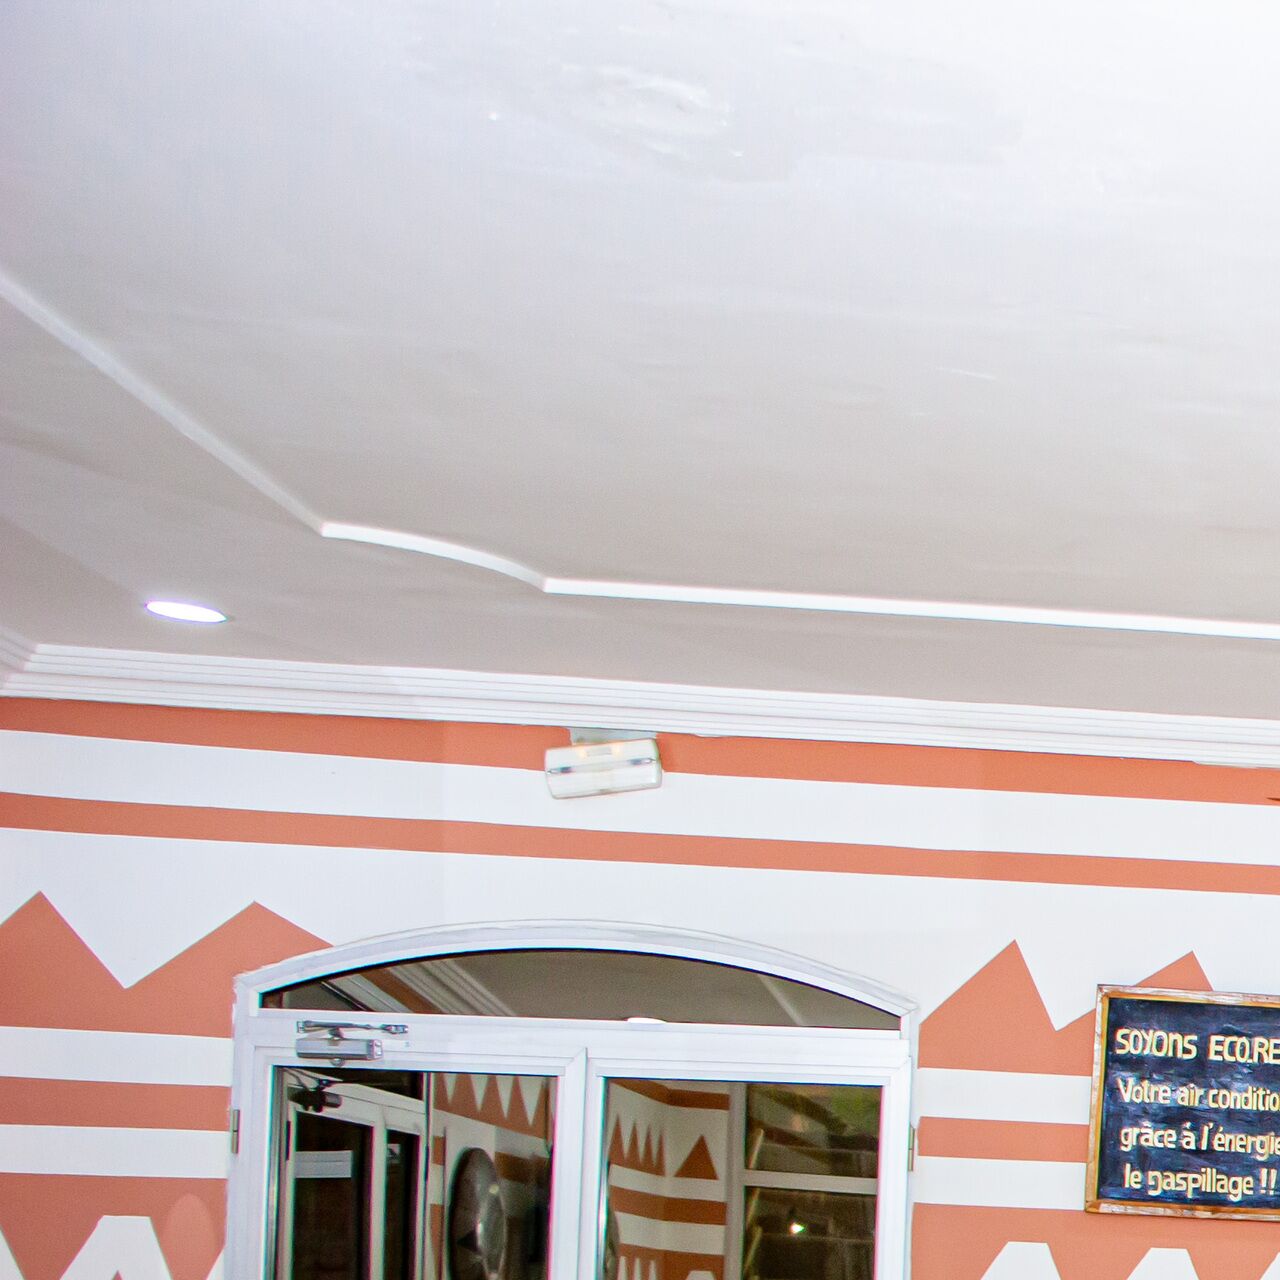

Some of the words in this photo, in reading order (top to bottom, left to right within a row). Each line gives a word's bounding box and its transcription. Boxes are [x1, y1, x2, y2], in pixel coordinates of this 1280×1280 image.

[1116, 1077, 1171, 1104] Votre
[1176, 1083, 1203, 1107] air
[1123, 1163, 1142, 1189] le
[1147, 1167, 1254, 1202] gaspillage
